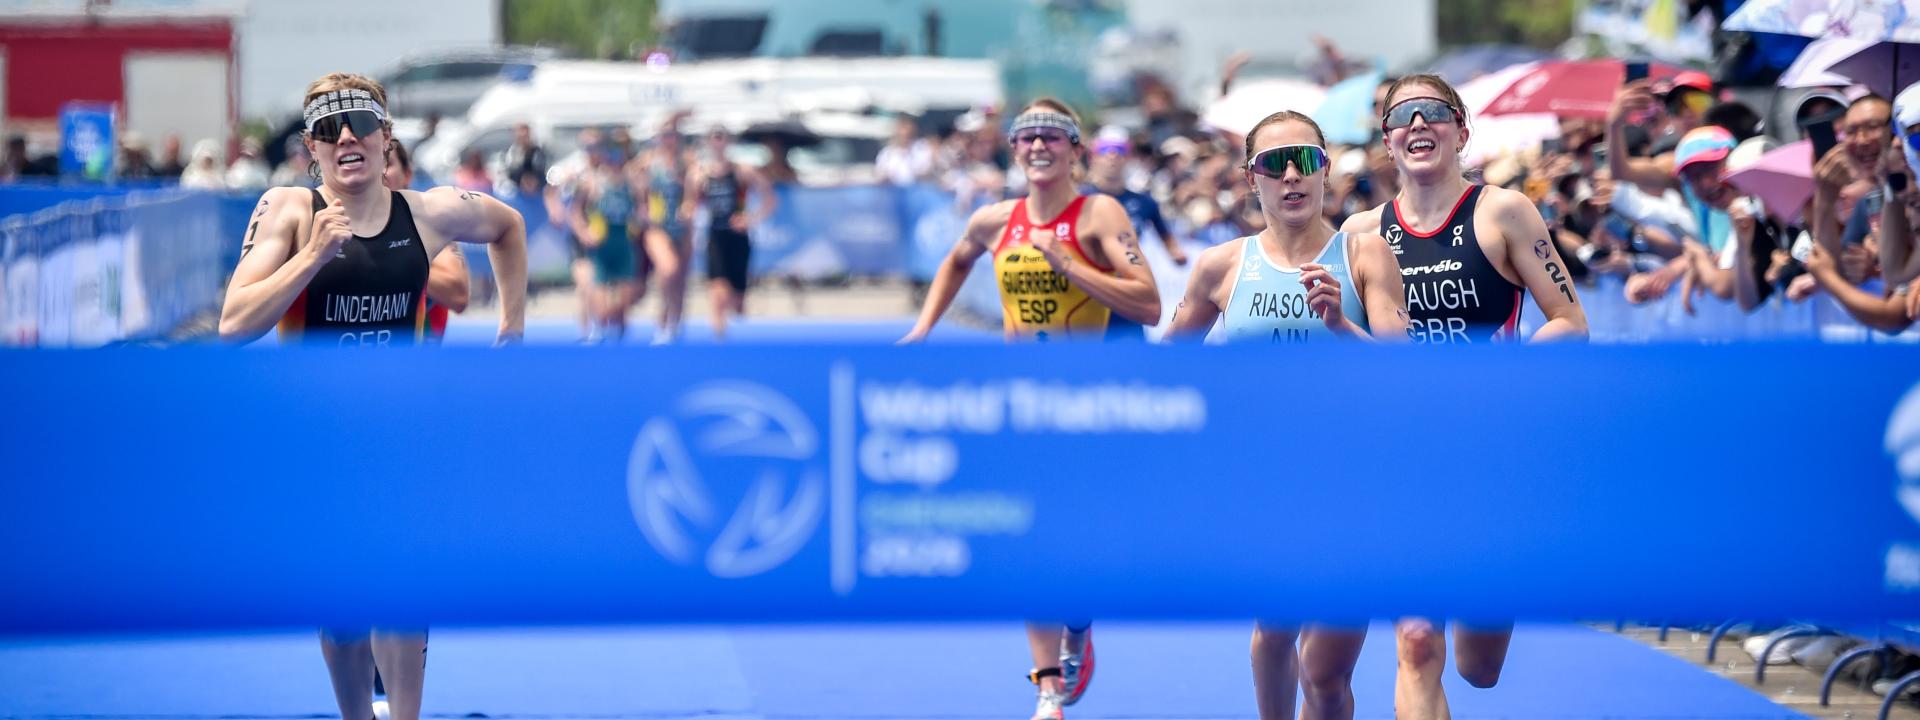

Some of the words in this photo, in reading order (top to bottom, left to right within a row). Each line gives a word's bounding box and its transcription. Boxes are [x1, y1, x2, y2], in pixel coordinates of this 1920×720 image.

[1003, 271, 1069, 294] GUERRERO
[1400, 260, 1463, 276] ervélo
[1544, 262, 1575, 304] 21
[325, 291, 411, 323] LINDEMANN
[1018, 299, 1058, 324] ESP
[1402, 278, 1480, 312] AUGH
[862, 382, 1003, 432] World
[1008, 380, 1205, 432] Triathlon
[861, 432, 958, 486] Cup
